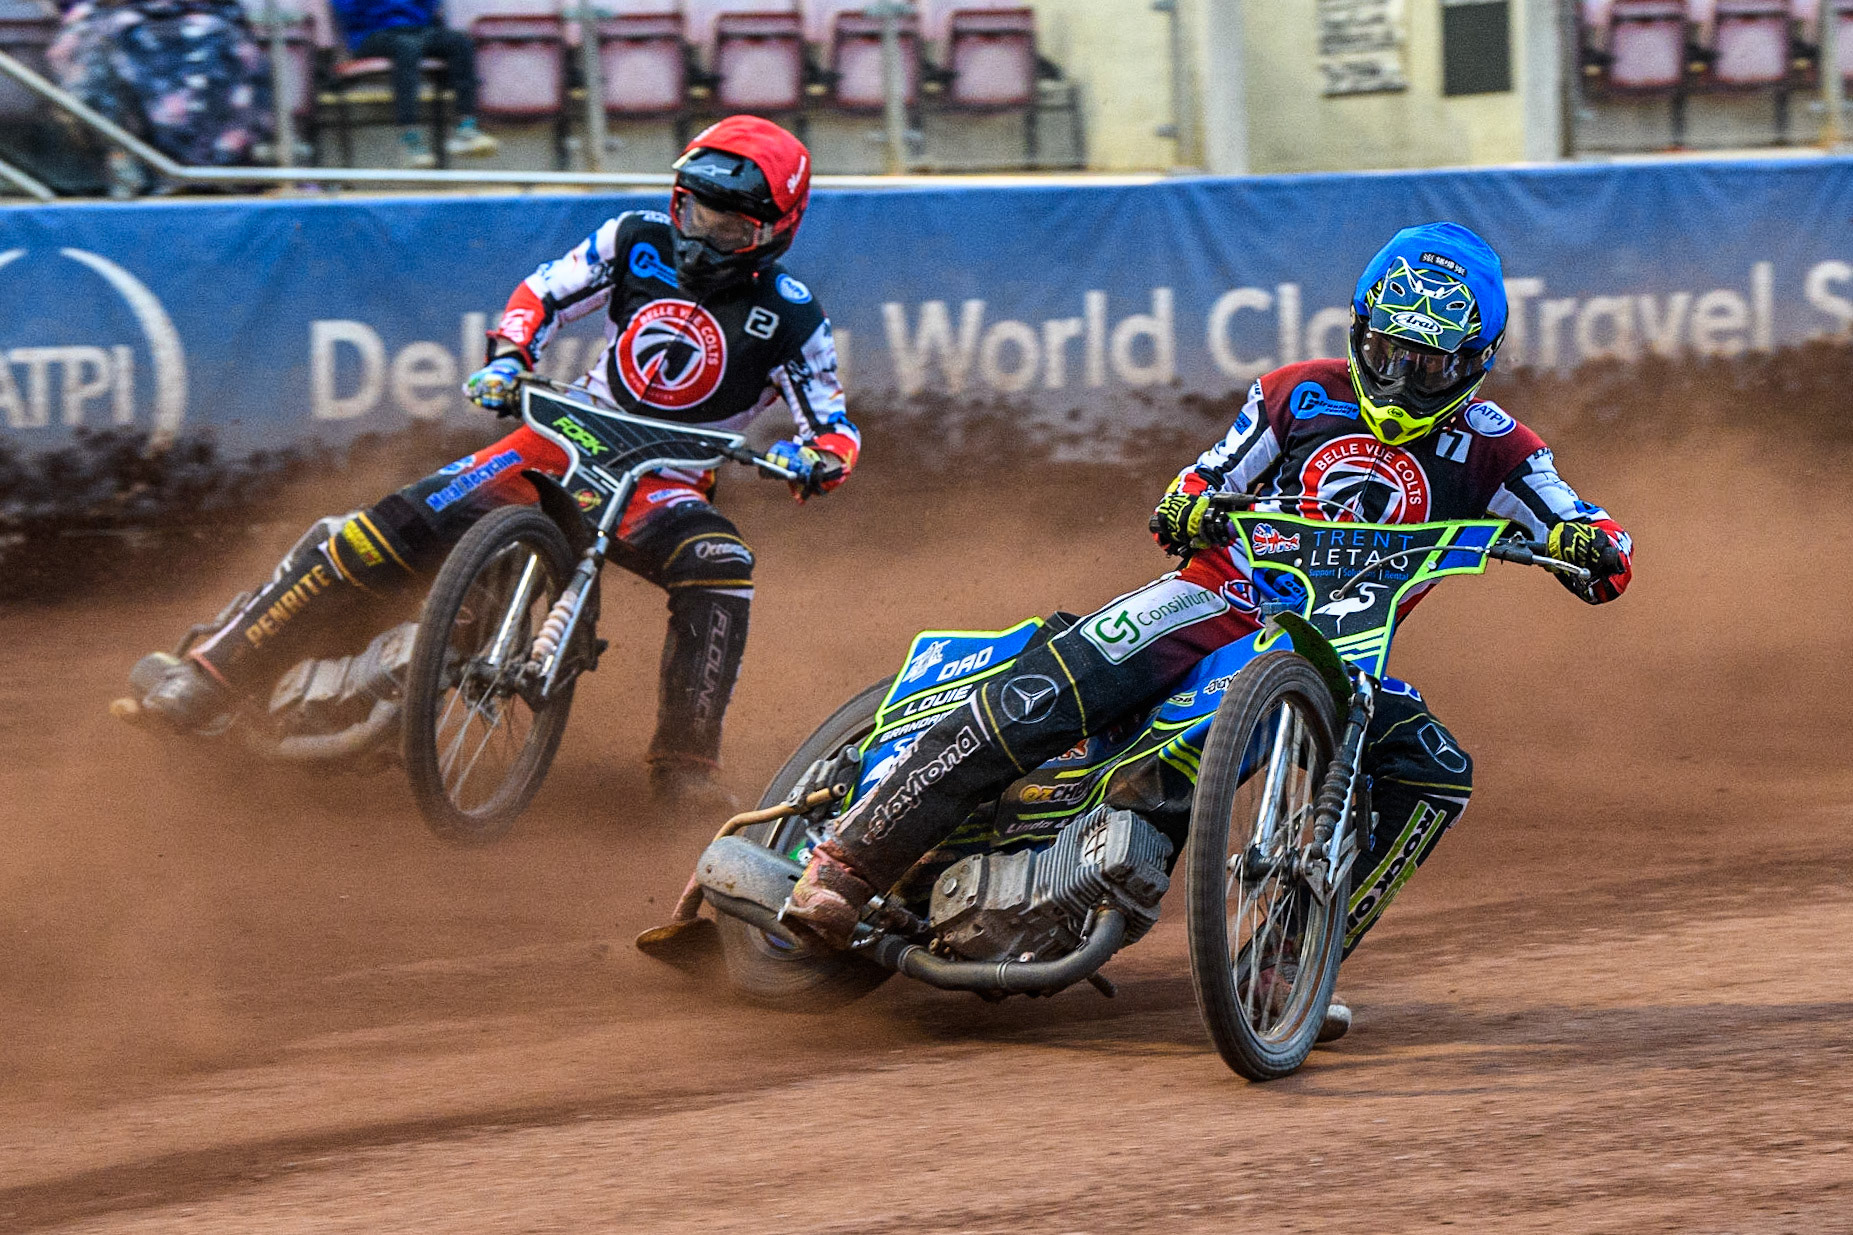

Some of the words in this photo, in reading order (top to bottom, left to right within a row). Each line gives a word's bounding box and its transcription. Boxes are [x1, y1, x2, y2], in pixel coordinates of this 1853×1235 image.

[639, 305, 675, 326] BELLE
[700, 326, 720, 366] COLTS
[882, 286, 1174, 396] World
[1503, 262, 1774, 366] Travel
[1404, 314, 1436, 331] Arai
[1473, 404, 1507, 426] ATPI
[1314, 443, 1359, 472] BELLE
[1365, 443, 1396, 464] VUE
[1395, 460, 1422, 506] COLTS
[1313, 529, 1414, 551] TRENT
[1384, 569, 1409, 580] Rental
[1136, 588, 1217, 628] Consilium
[935, 645, 994, 682] DAD
[903, 684, 974, 717] LOUIE
